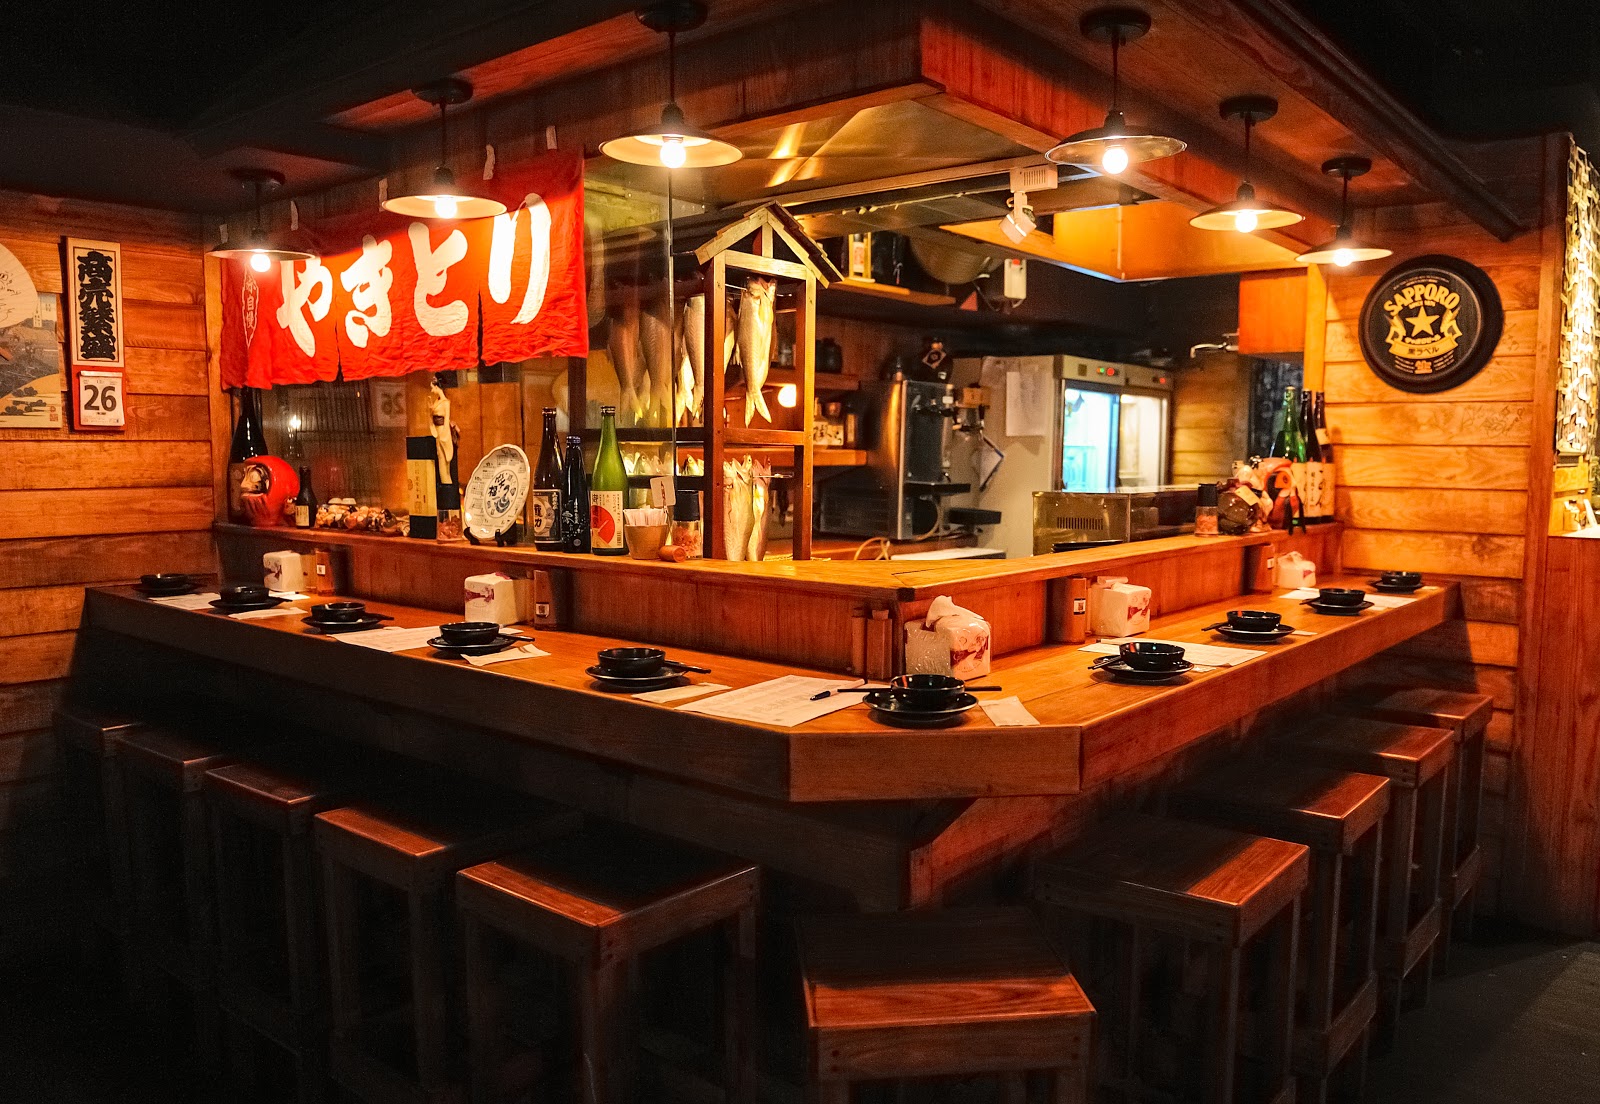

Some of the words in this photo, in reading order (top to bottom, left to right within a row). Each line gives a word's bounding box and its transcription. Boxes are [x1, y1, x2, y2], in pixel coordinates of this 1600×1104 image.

[276, 192, 552, 358] やきとり
[1384, 283, 1461, 316] SAPPORO
[84, 384, 117, 412] 26
